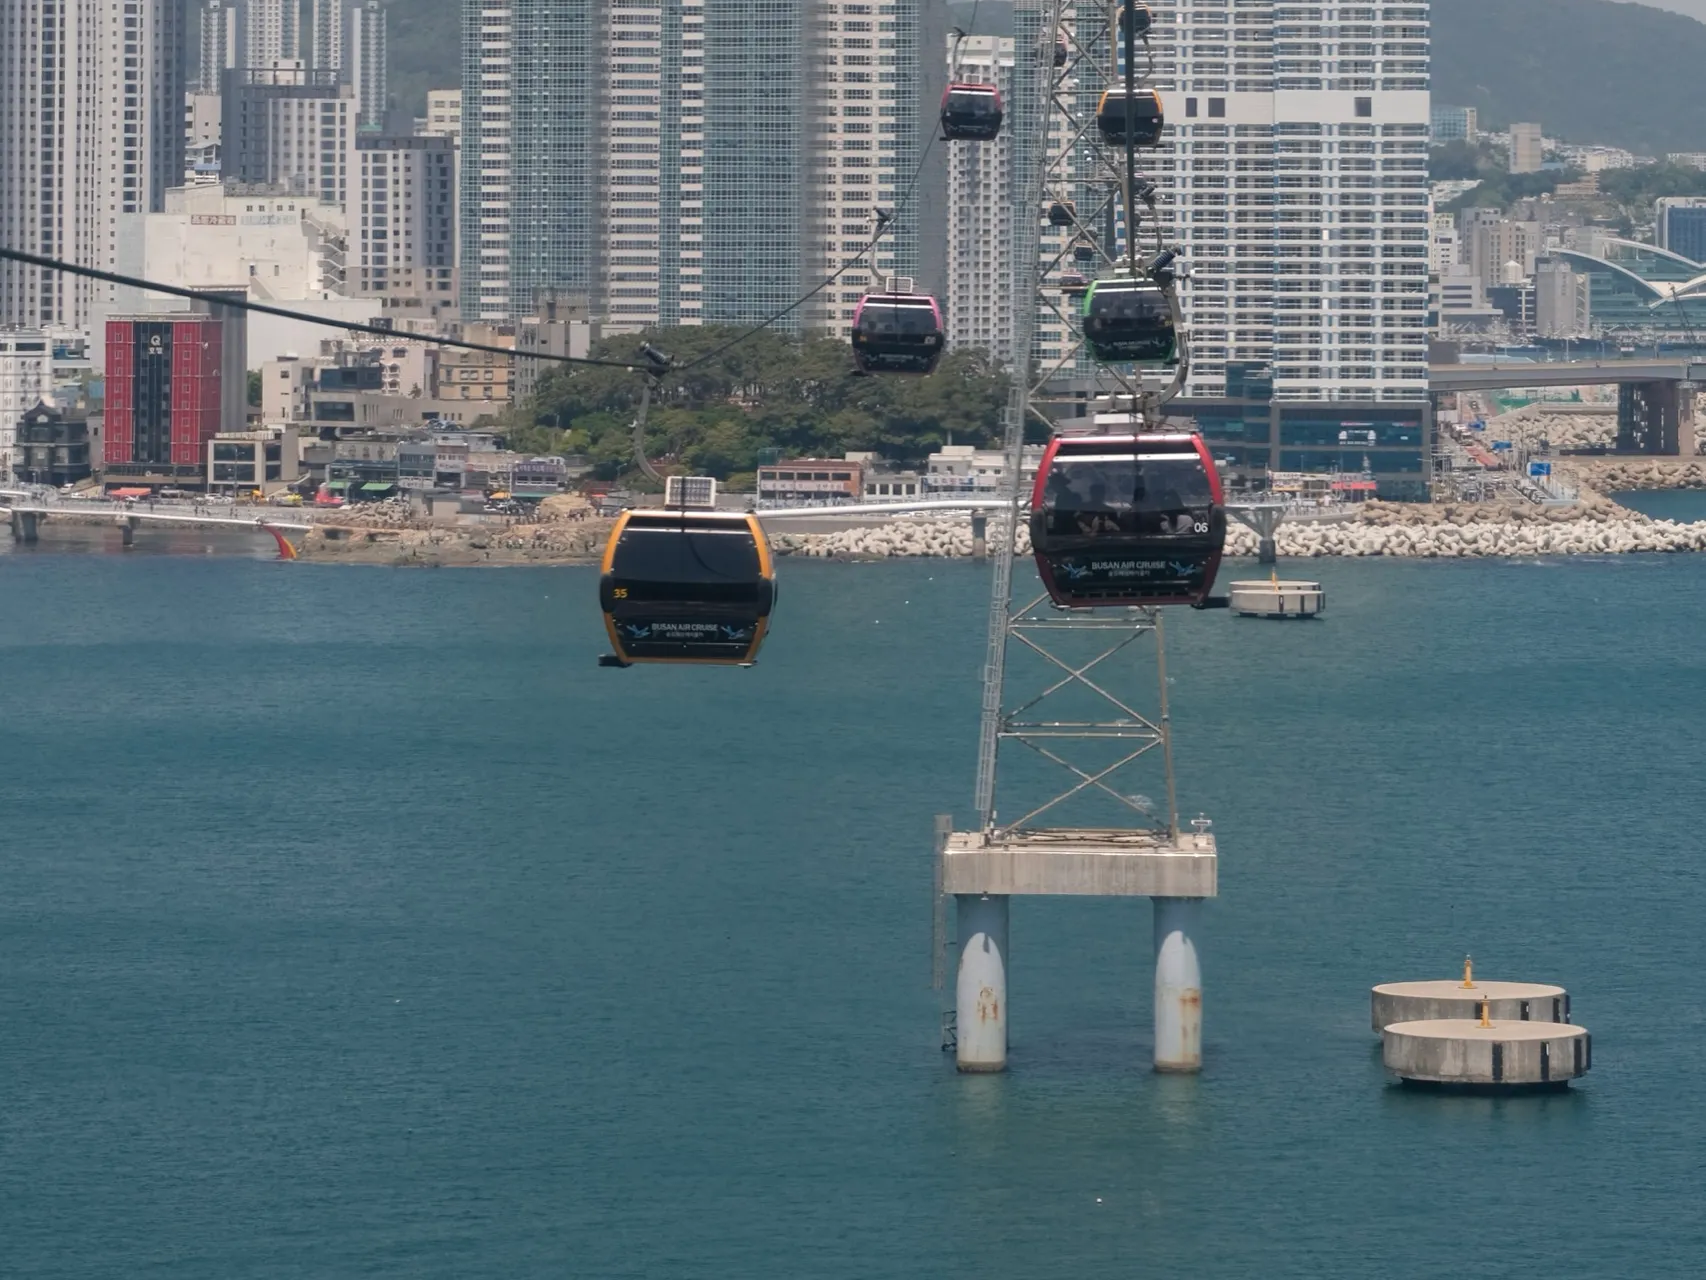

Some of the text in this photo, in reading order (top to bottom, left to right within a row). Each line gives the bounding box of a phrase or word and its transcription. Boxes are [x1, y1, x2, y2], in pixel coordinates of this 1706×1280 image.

[151, 335, 161, 345] Q
[1194, 522, 1208, 533] 06
[1091, 561, 1166, 570] BUSAN AIR CRUISE
[613, 588, 628, 598] 35
[651, 623, 718, 632] BUSAN AIR CRUISE
